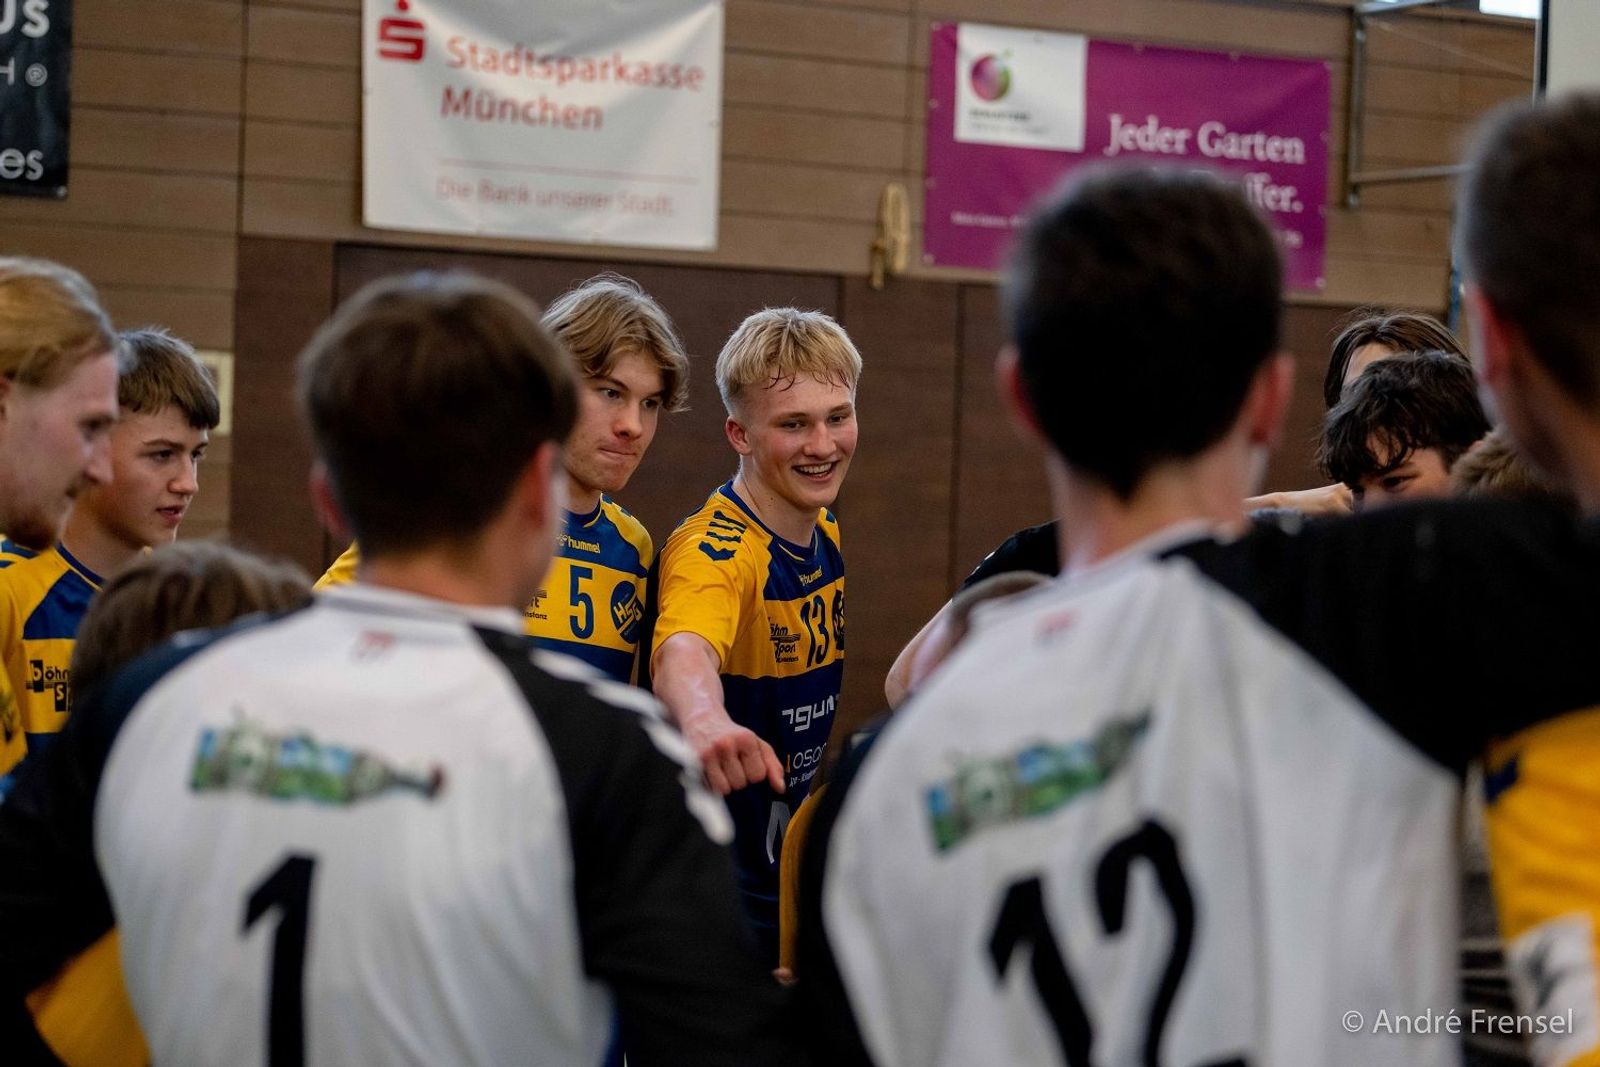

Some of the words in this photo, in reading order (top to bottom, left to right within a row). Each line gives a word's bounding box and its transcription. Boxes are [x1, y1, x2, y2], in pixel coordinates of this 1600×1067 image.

[447, 35, 705, 92] Stadtsparkasse
[440, 84, 605, 130] München
[1103, 113, 1192, 157] Jeder
[1197, 120, 1305, 165] Garten
[568, 537, 601, 554] hummel
[569, 564, 594, 640] 5
[612, 594, 644, 624] HSG
[800, 594, 830, 669] 13
[243, 853, 319, 1067] 1
[987, 818, 1252, 1067] 12
